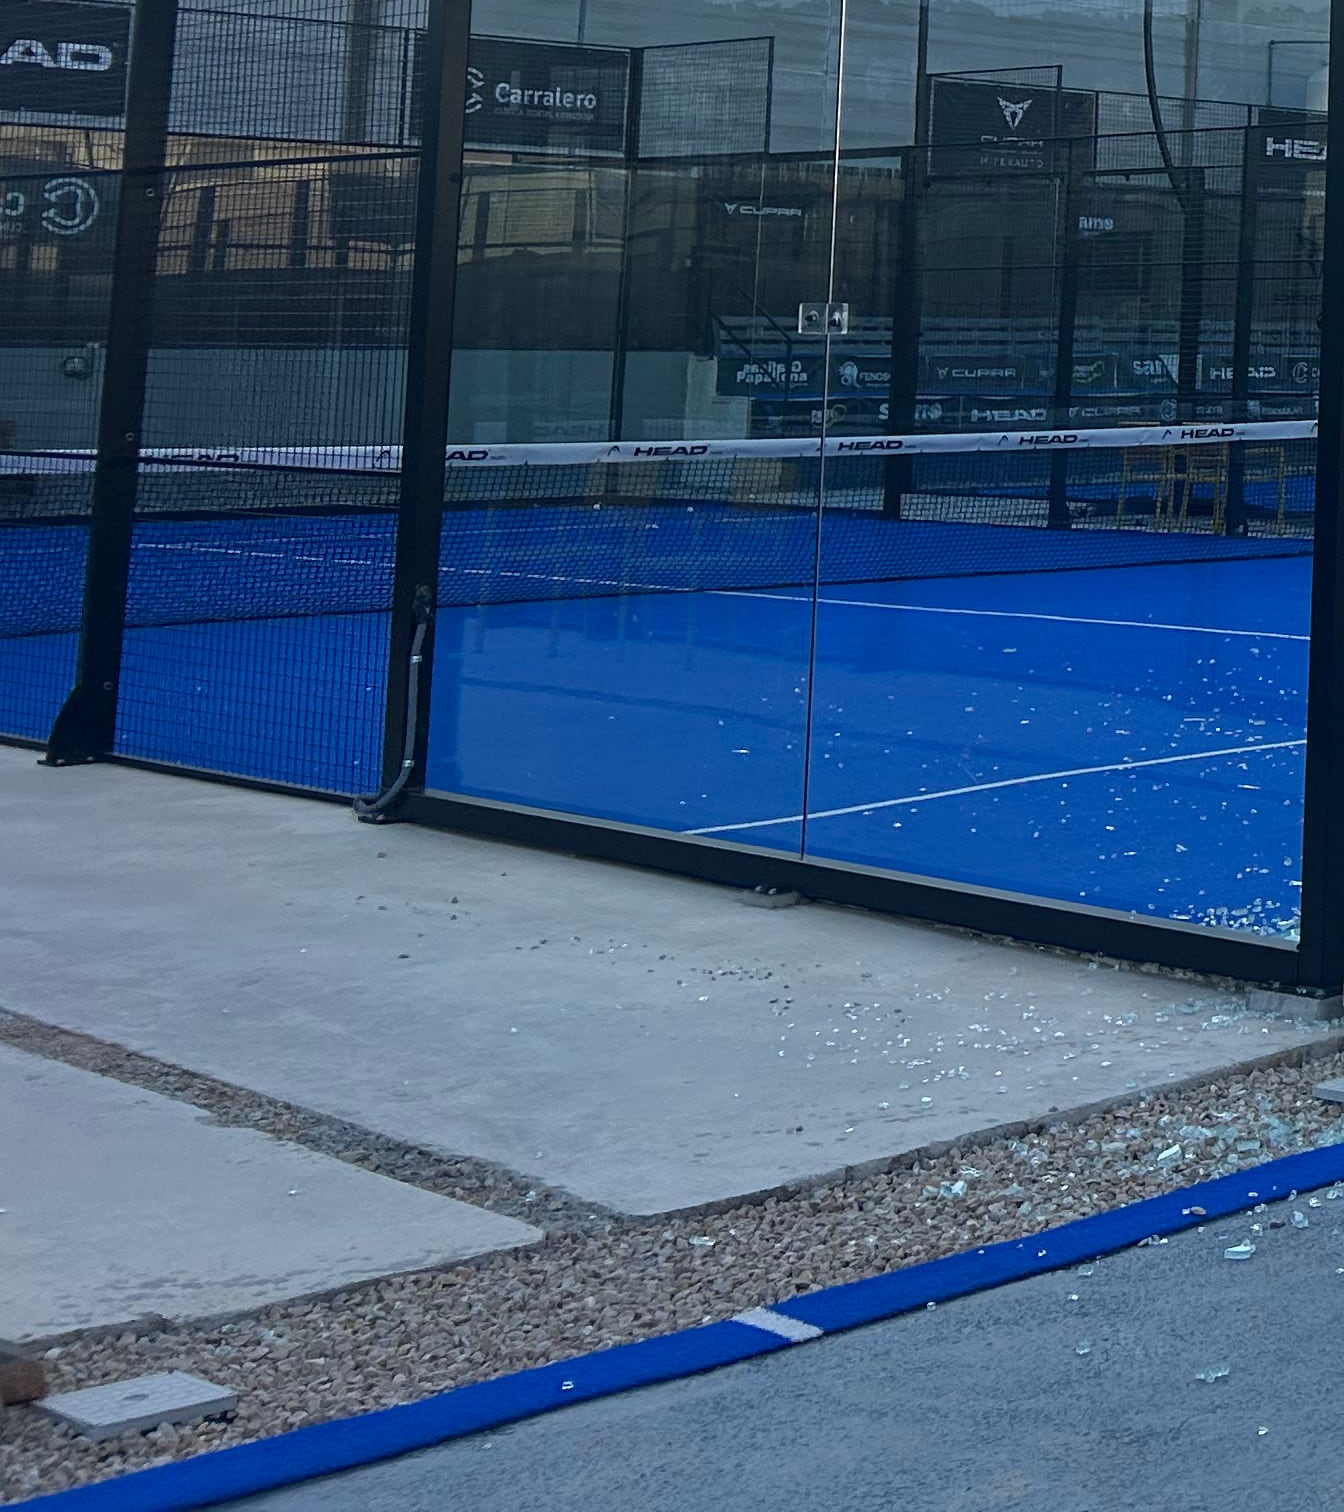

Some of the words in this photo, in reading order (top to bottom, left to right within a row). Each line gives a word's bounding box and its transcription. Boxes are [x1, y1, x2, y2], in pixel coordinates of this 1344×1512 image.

[0, 39, 112, 71] AD
[495, 82, 597, 109] Carralero
[1266, 137, 1327, 161] HE
[740, 205, 801, 217] CUPRA
[952, 367, 1016, 378] CUPRA
[1181, 428, 1235, 439] HEAD
[838, 440, 903, 451] HEAD
[1019, 435, 1078, 445] HEAD
[445, 450, 489, 461] AD
[634, 445, 708, 457] HEAD
